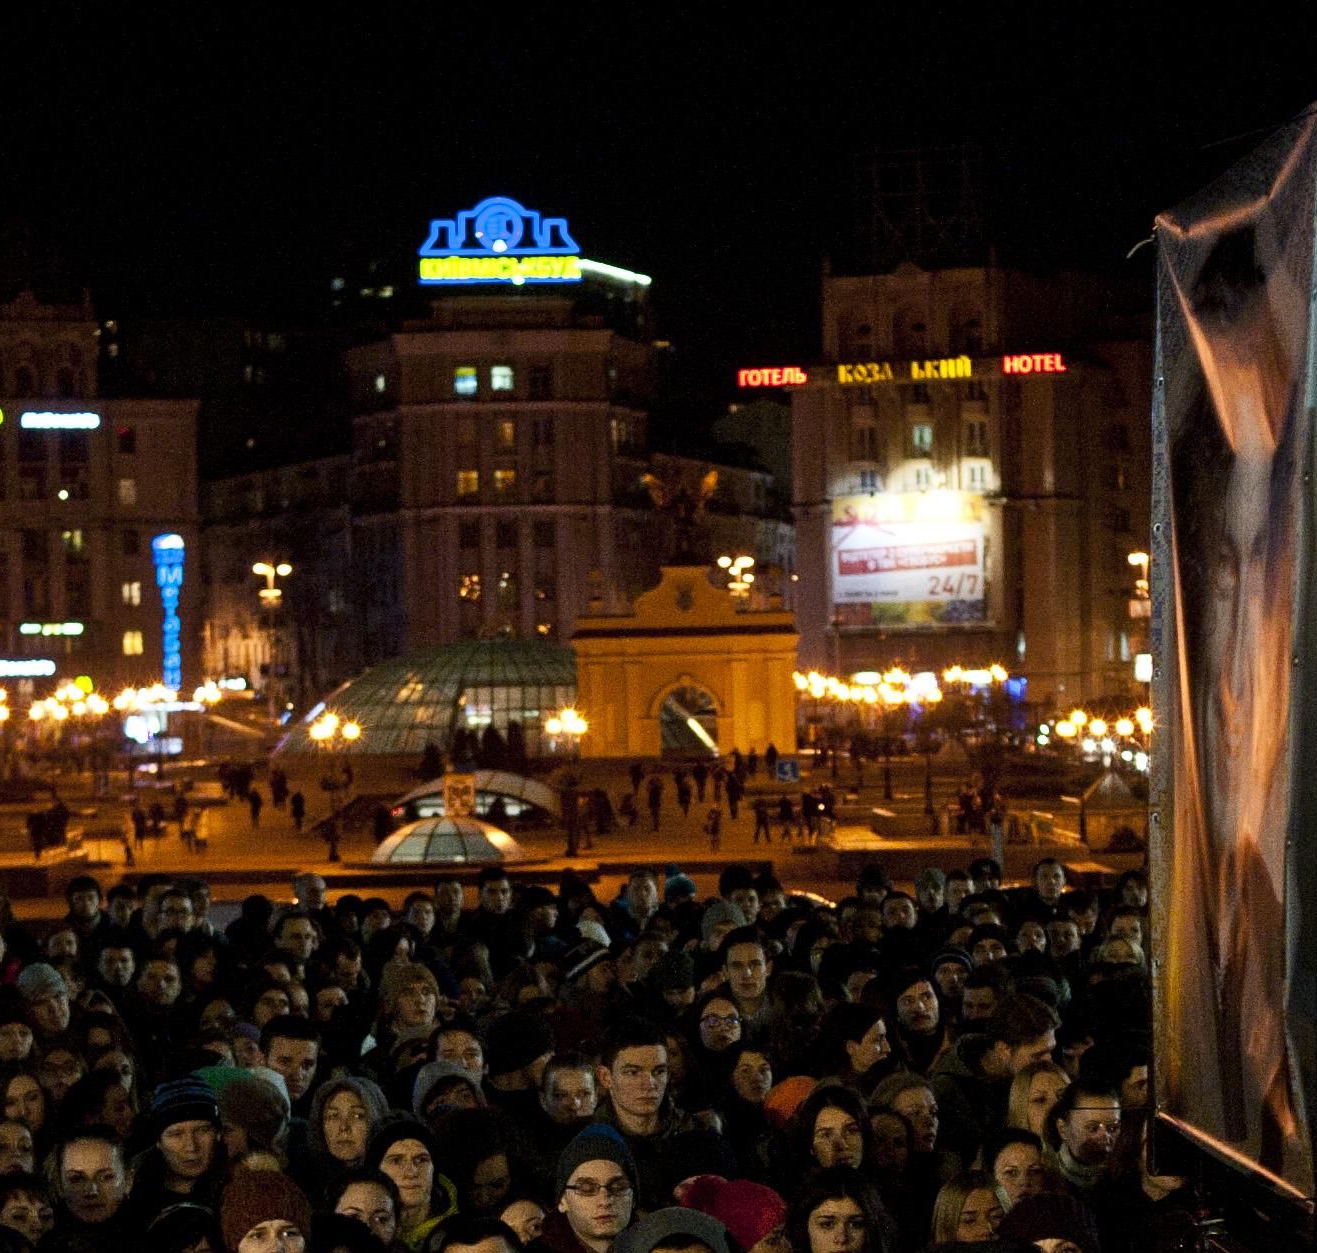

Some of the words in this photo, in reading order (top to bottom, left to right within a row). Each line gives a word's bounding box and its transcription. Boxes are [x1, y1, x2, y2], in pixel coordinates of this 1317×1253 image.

[738, 366, 808, 388] ГОТЕЛЬ
[1003, 353, 1067, 374] HOTEL
[928, 573, 980, 597] 24/7
